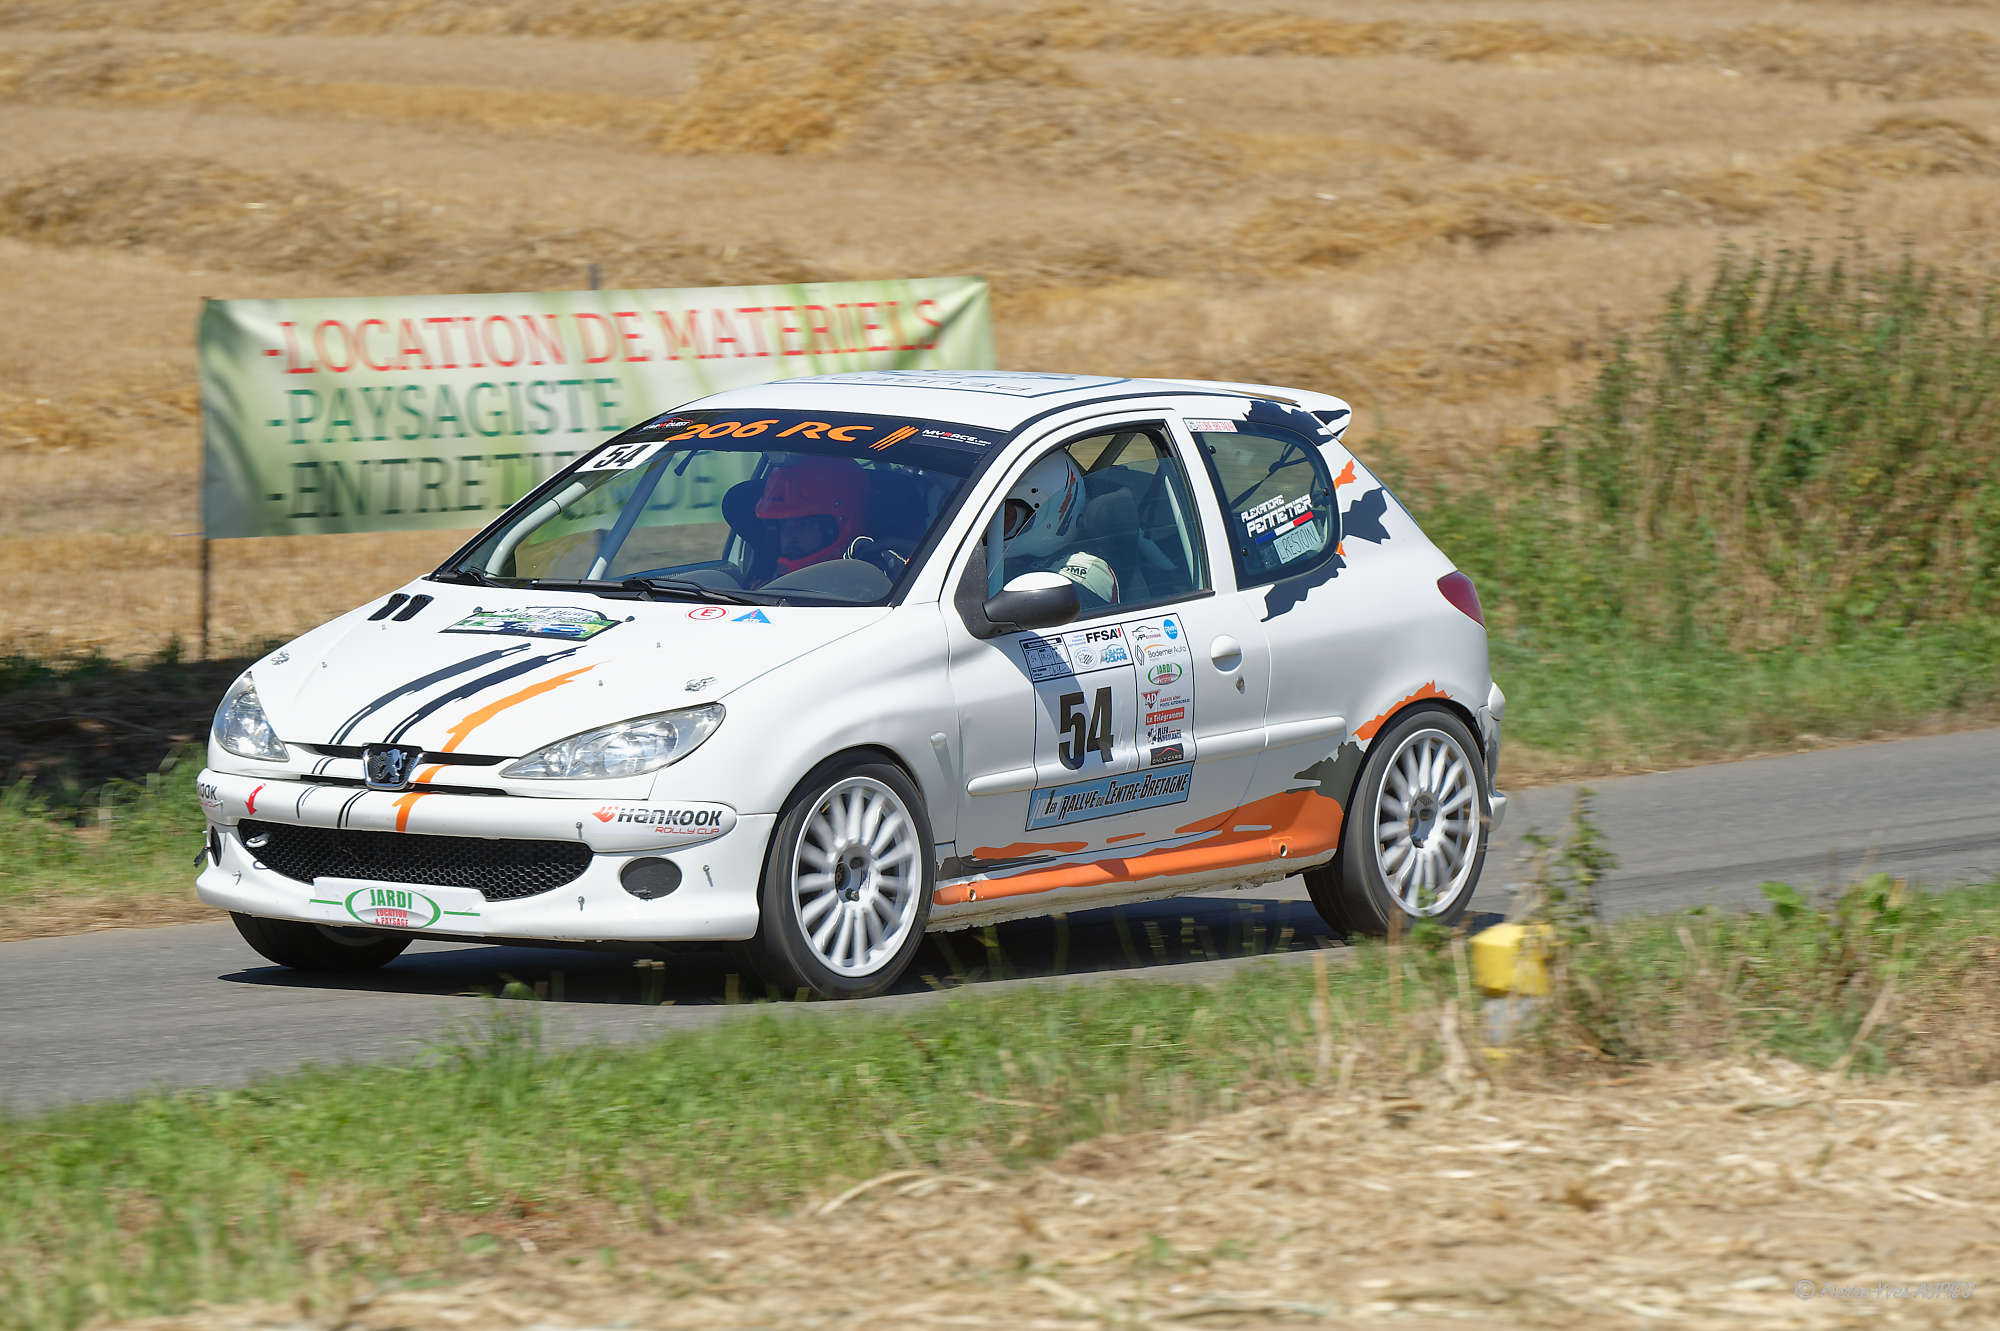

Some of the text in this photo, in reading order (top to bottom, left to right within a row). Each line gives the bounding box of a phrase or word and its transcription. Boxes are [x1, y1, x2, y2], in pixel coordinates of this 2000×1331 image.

[263, 298, 945, 374] -LOCATION DE MATERIELS
[266, 377, 621, 444] -PAYSAGISTE
[664, 419, 874, 443] 206 RC
[593, 444, 650, 469] 54
[1246, 493, 1313, 538] PENNETIER
[1085, 628, 1119, 644] FFSA
[1058, 686, 1114, 770] 54
[1058, 791, 1099, 820] RALLYE
[1104, 774, 1189, 805] CENTRE-BRETAGNE
[370, 888, 413, 910] JARDI
[376, 908, 408, 918] LOCATION
[381, 918, 409, 928] PAYSAGE
